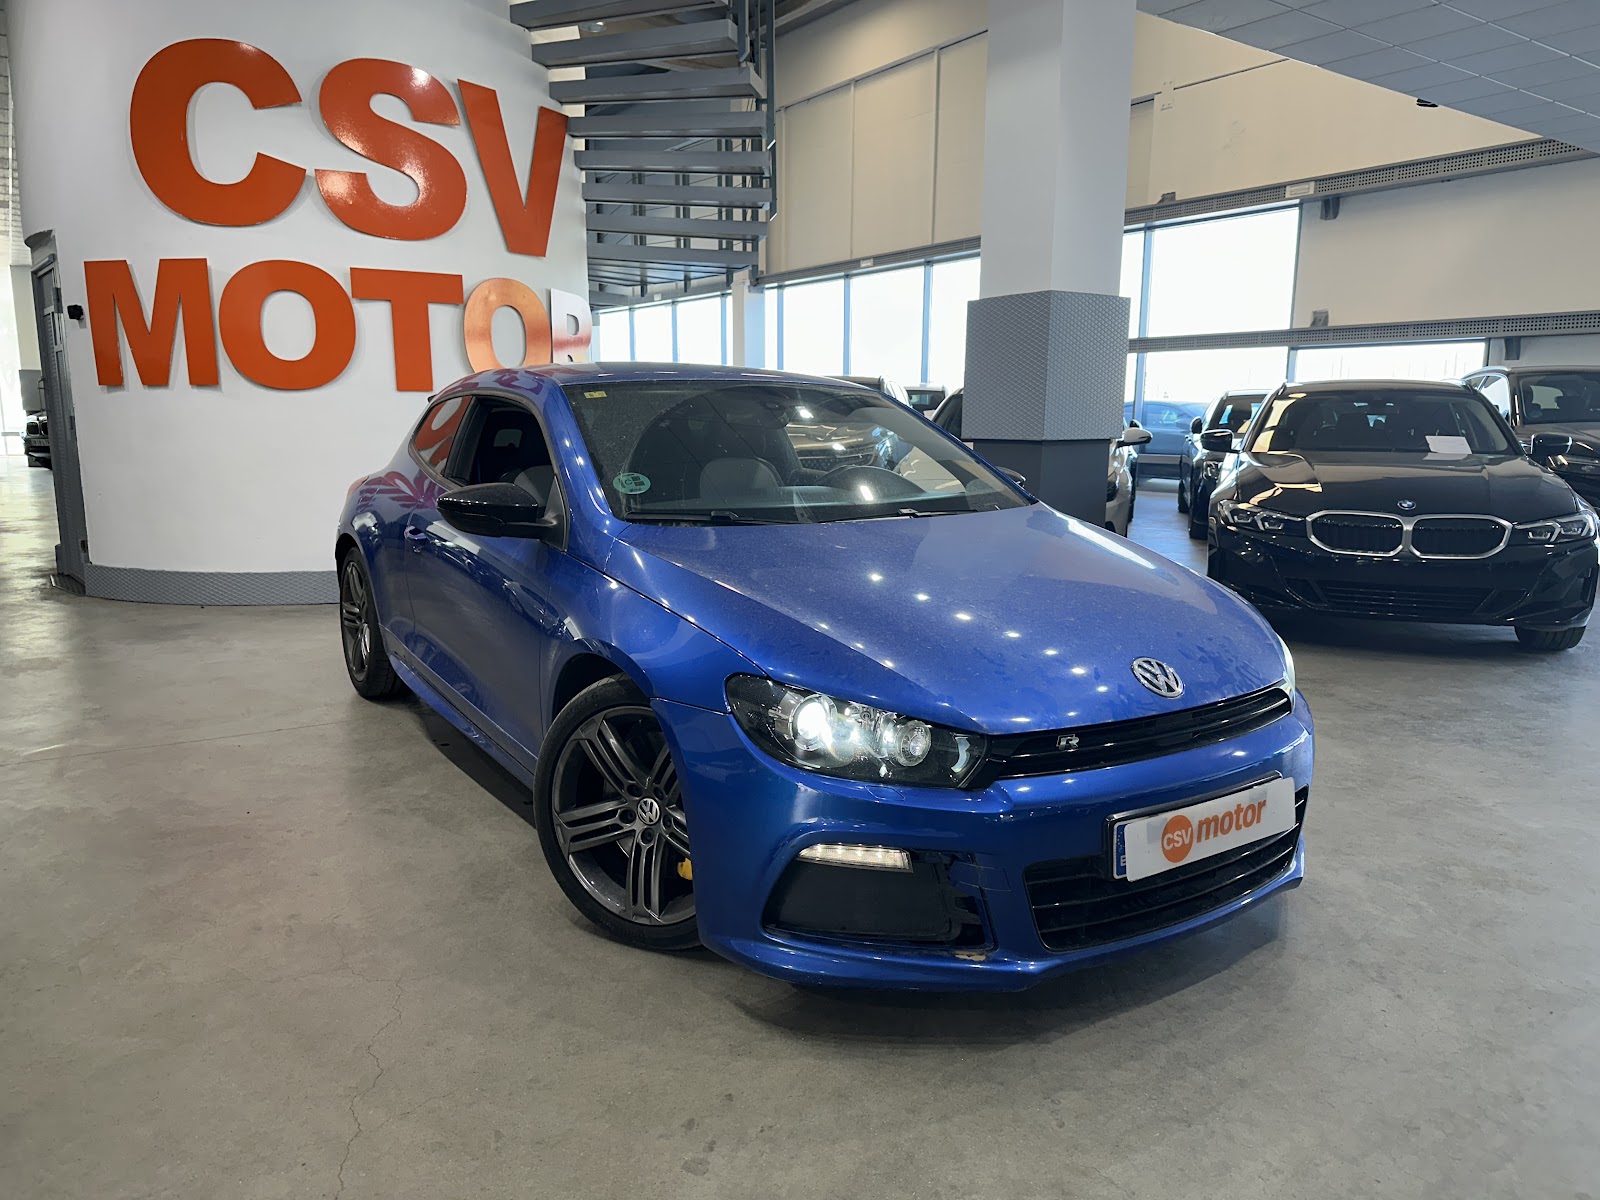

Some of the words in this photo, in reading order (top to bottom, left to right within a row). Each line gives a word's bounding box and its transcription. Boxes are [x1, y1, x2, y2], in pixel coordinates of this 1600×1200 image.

[130, 38, 569, 257] CSV
[84, 258, 592, 391] MOTOR
[1056, 734, 1079, 750] R
[1163, 827, 1192, 850] CSV
[1197, 800, 1267, 843] motor
